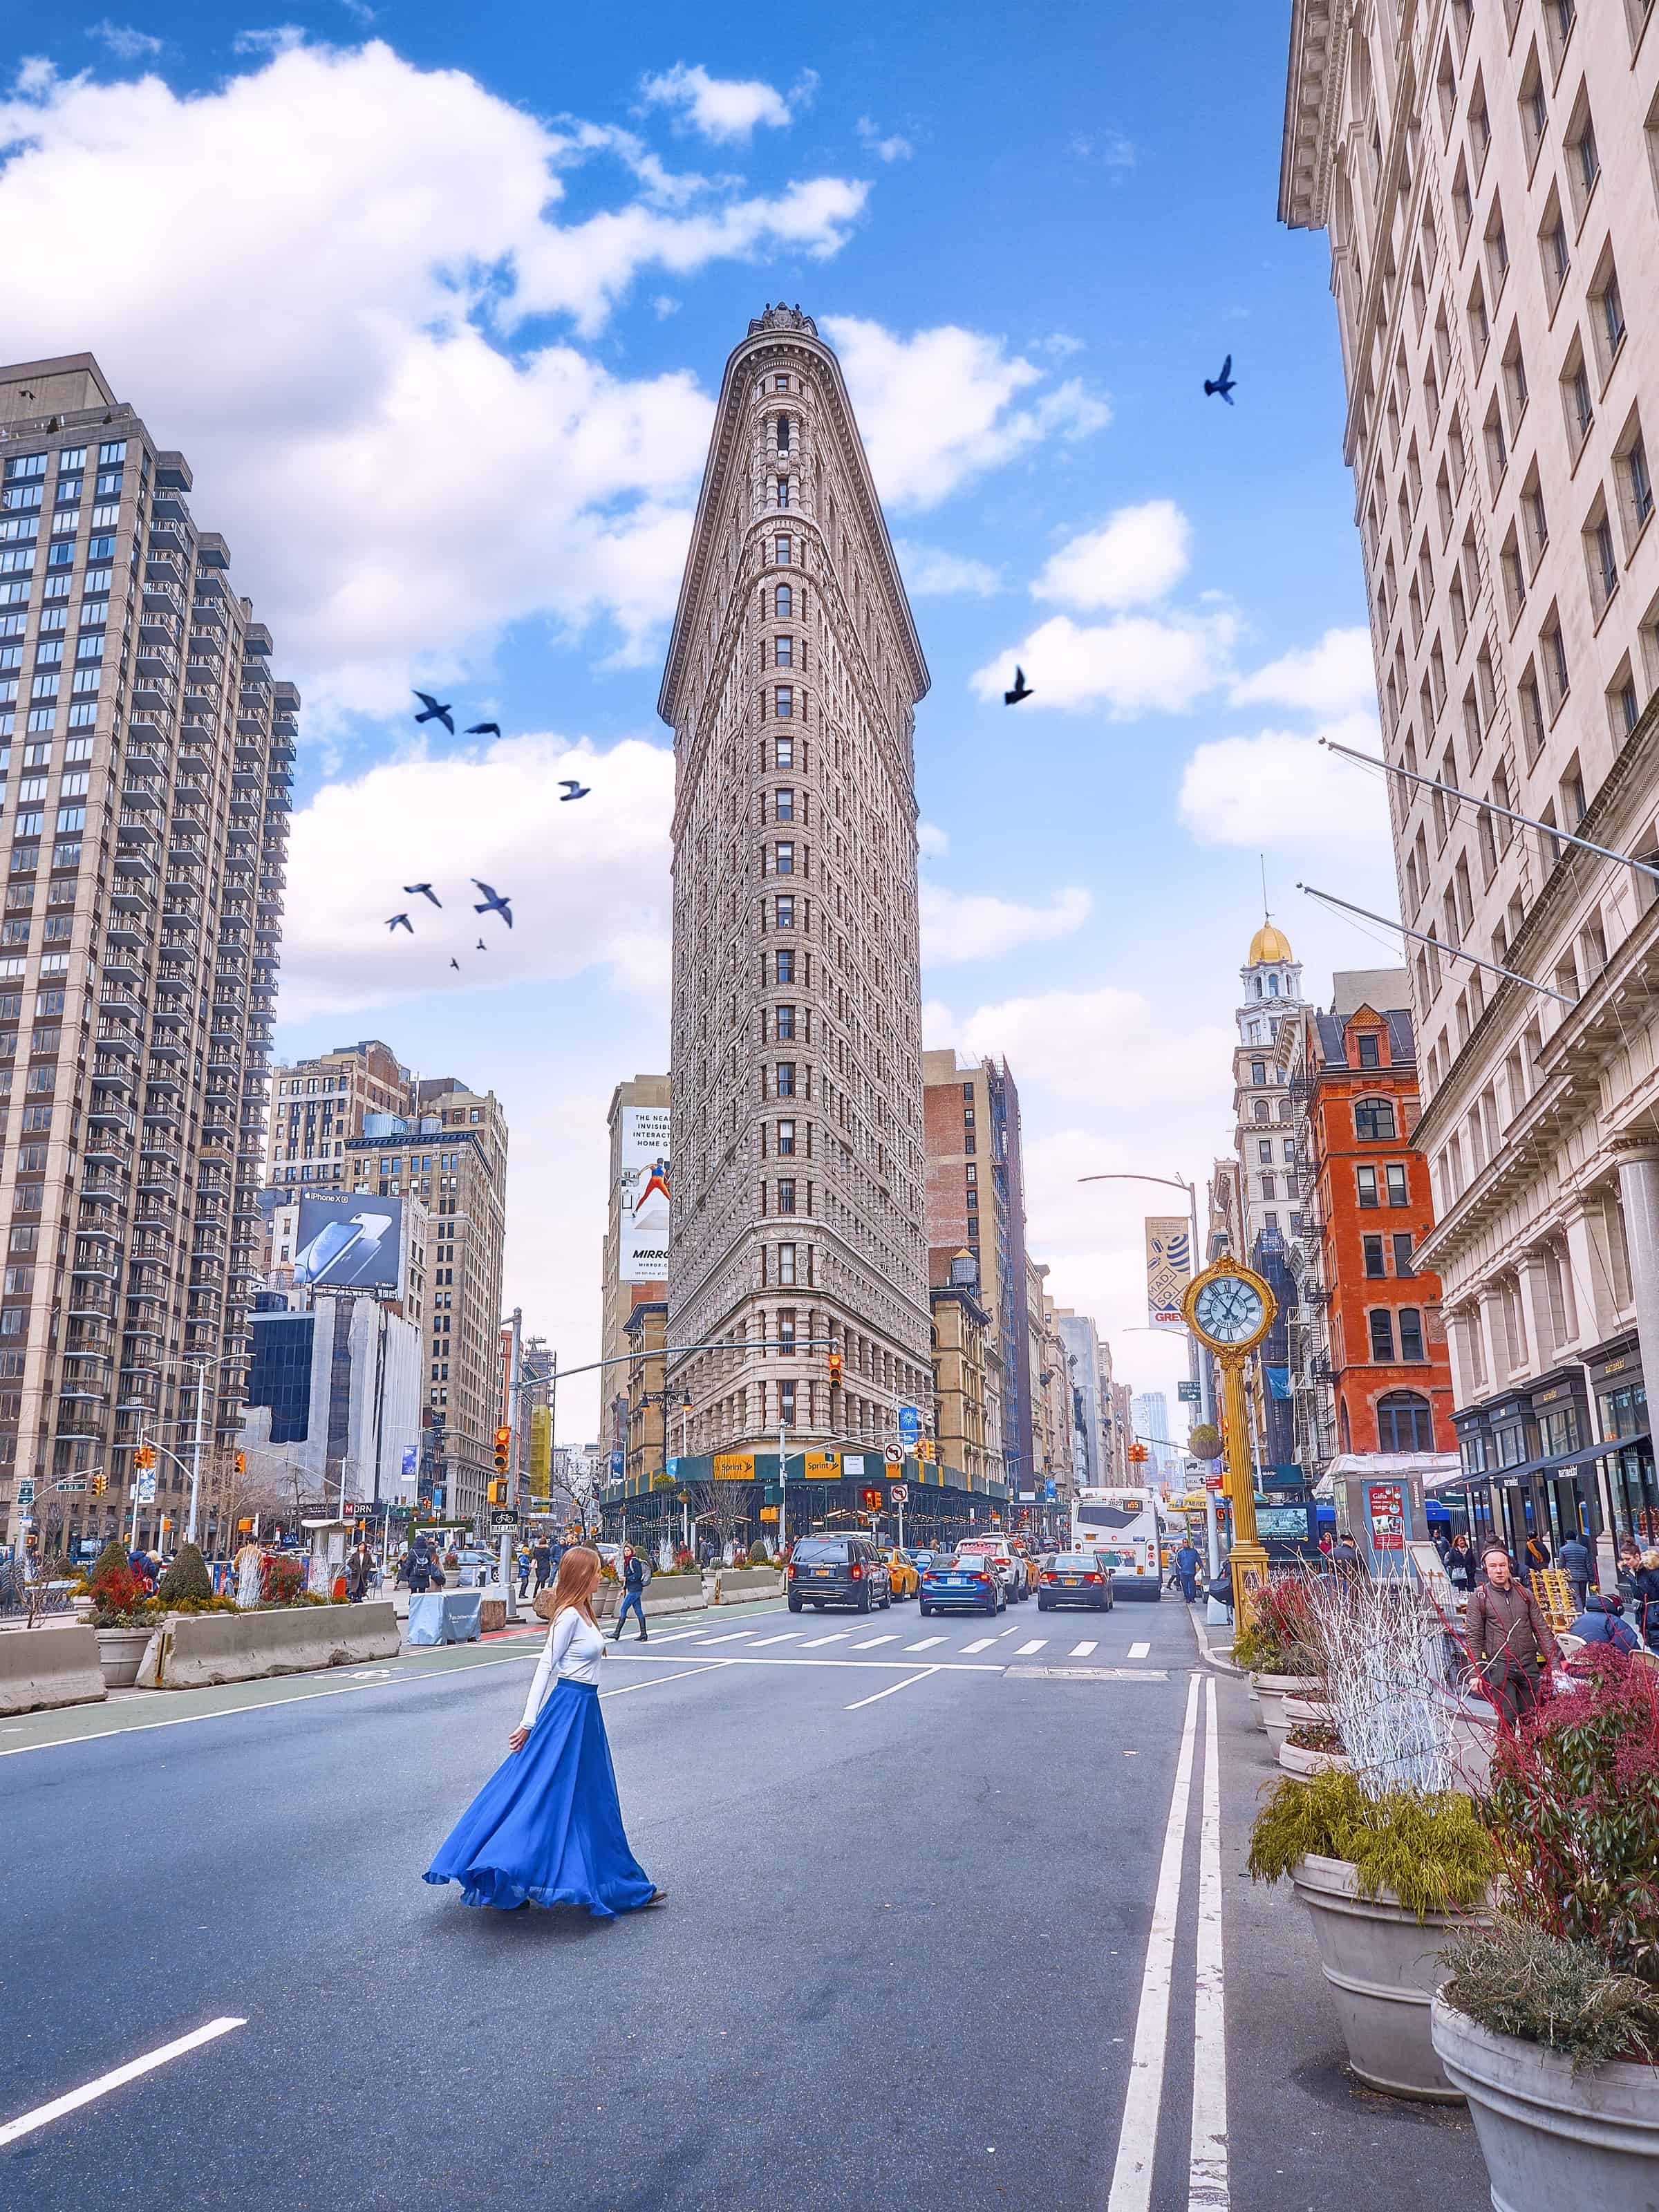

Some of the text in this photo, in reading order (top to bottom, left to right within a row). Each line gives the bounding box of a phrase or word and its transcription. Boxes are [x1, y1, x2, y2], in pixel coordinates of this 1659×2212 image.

[310, 1192, 335, 1202] iPhone
[1149, 1274, 1172, 1296] MAD.
[1158, 1291, 1176, 1306] SQ.
[1155, 1313, 1183, 1322] GREY
[1217, 1318, 1244, 1327] BUILDING
[808, 1462, 829, 1470] Sprint
